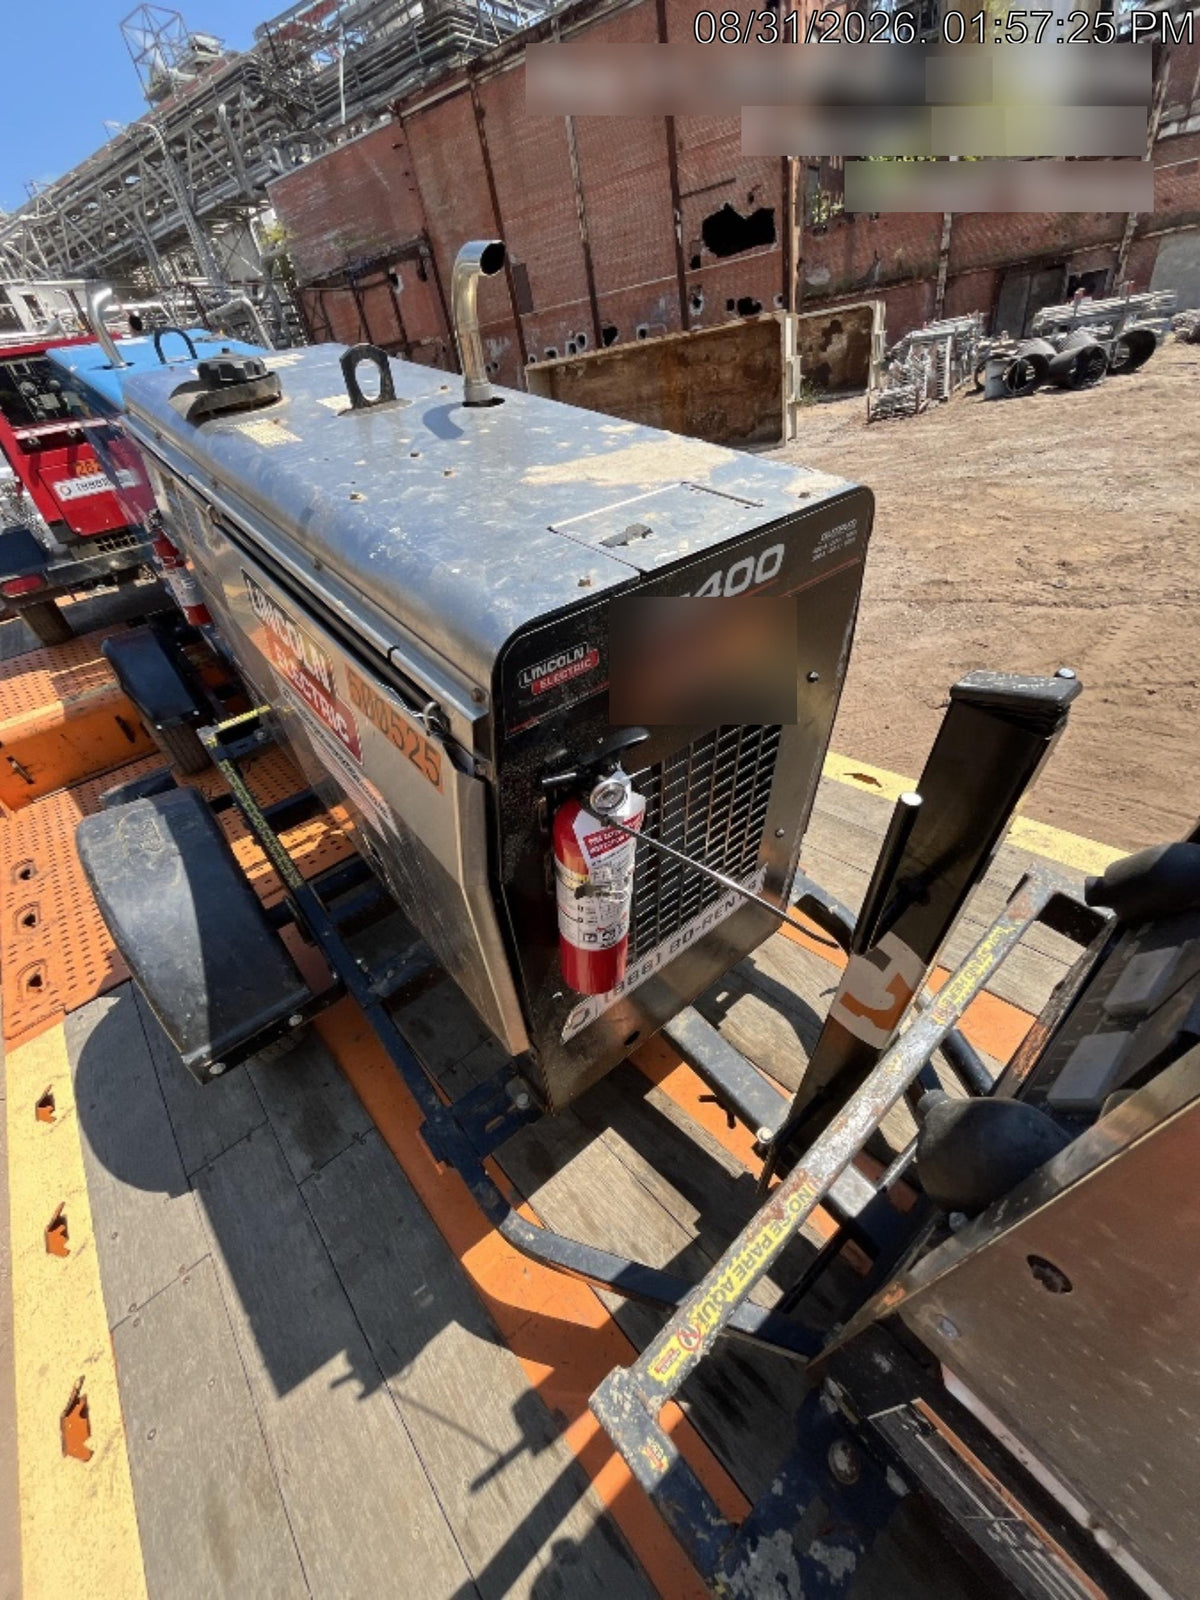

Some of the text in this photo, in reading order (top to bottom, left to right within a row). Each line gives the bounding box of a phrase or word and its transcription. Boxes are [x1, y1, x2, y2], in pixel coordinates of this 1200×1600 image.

[694, 544, 785, 597] 400
[523, 646, 584, 684] LINCOLN
[540, 659, 591, 688] ELECTRIC
[788, 1187, 812, 1213] NO
[732, 1234, 773, 1280] PARE
